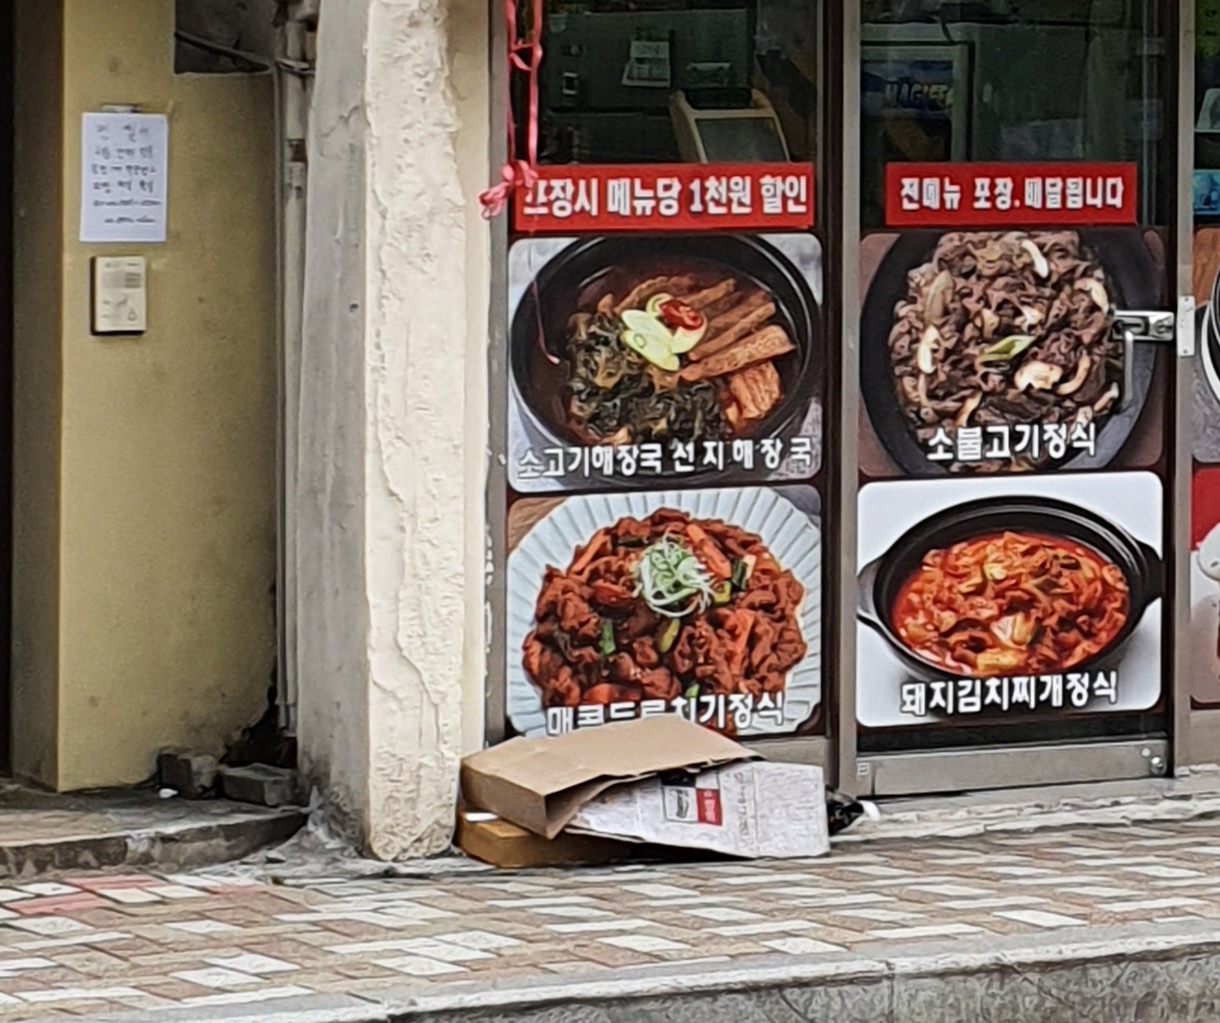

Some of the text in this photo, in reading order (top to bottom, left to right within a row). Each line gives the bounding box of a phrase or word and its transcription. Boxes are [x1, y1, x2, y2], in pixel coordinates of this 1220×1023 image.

[606, 177, 682, 216] 메뉴당
[689, 176, 752, 215] 1천원
[759, 175, 808, 213] 할인
[901, 177, 961, 210] 전메뉴
[926, 422, 1096, 461] 소불고기정식
[901, 670, 1118, 716] 돼지김치찌개정식
